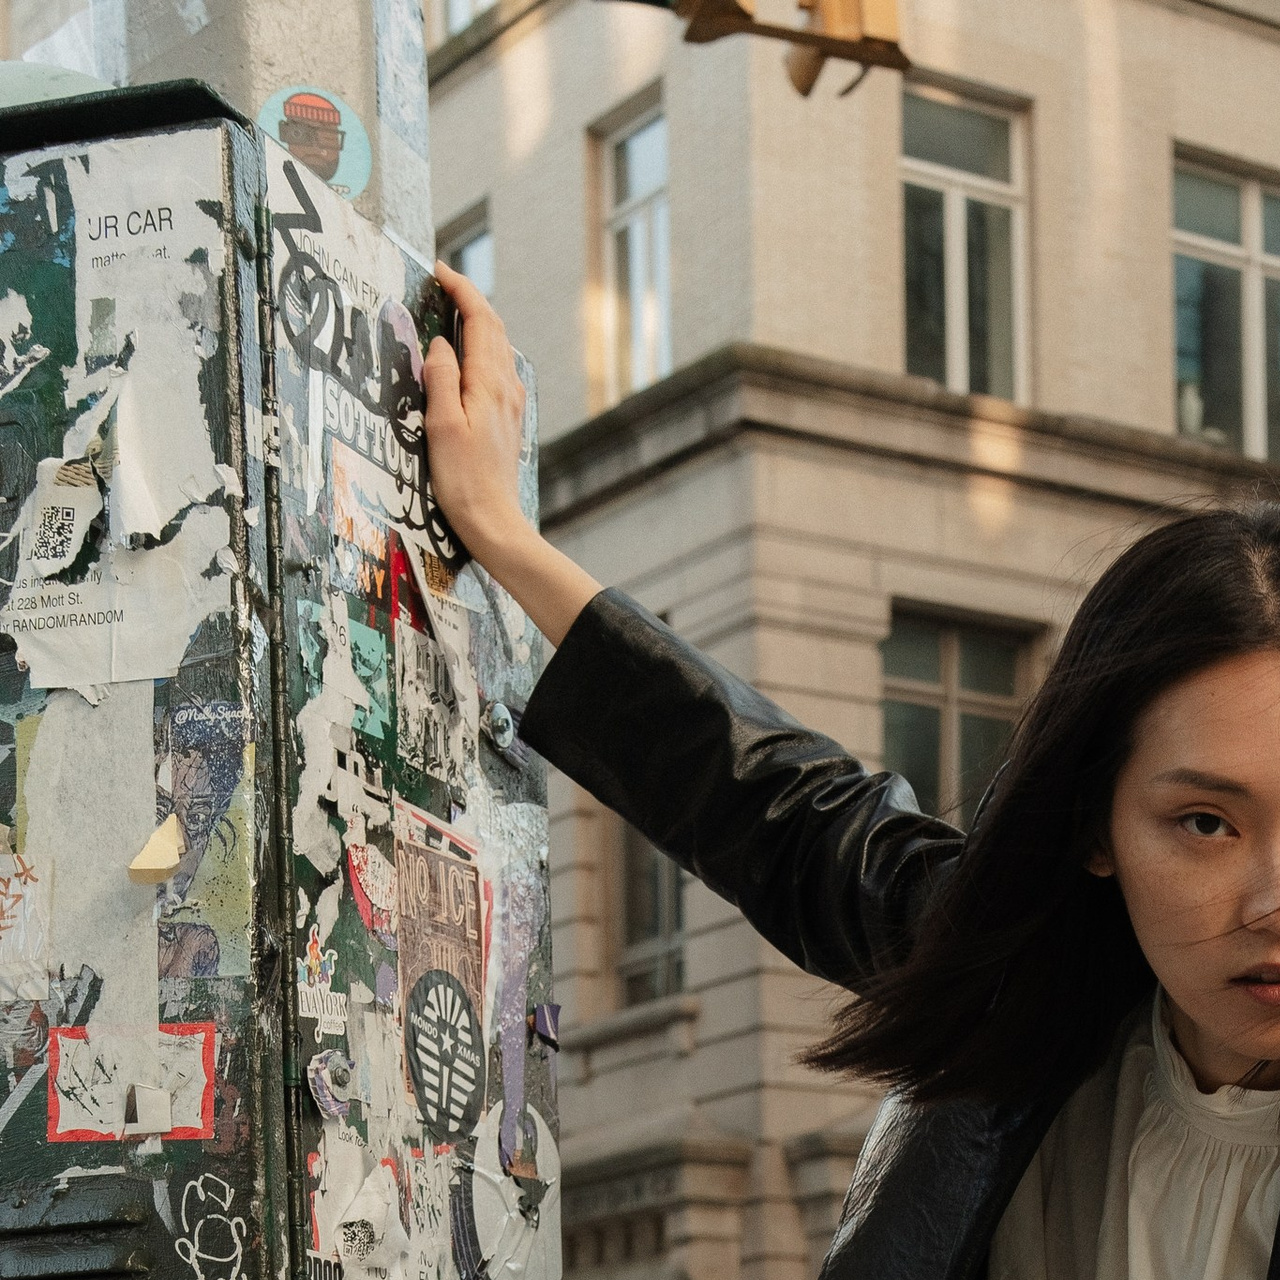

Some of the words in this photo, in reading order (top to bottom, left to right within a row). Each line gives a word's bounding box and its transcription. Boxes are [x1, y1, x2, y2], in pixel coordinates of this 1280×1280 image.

[126, 206, 174, 236] CAR
[333, 259, 359, 297] CAN
[17, 597, 38, 611] 228
[40, 591, 65, 609] Mott
[67, 591, 83, 606] St.
[12, 609, 125, 633] RANDOM/RANDOM
[398, 850, 431, 920] NO
[433, 859, 479, 941] ICE
[322, 1019, 344, 1033] coffee
[410, 1012, 438, 1039] MONDO
[457, 1042, 481, 1068] XMAS
[337, 1126, 354, 1144] Look
